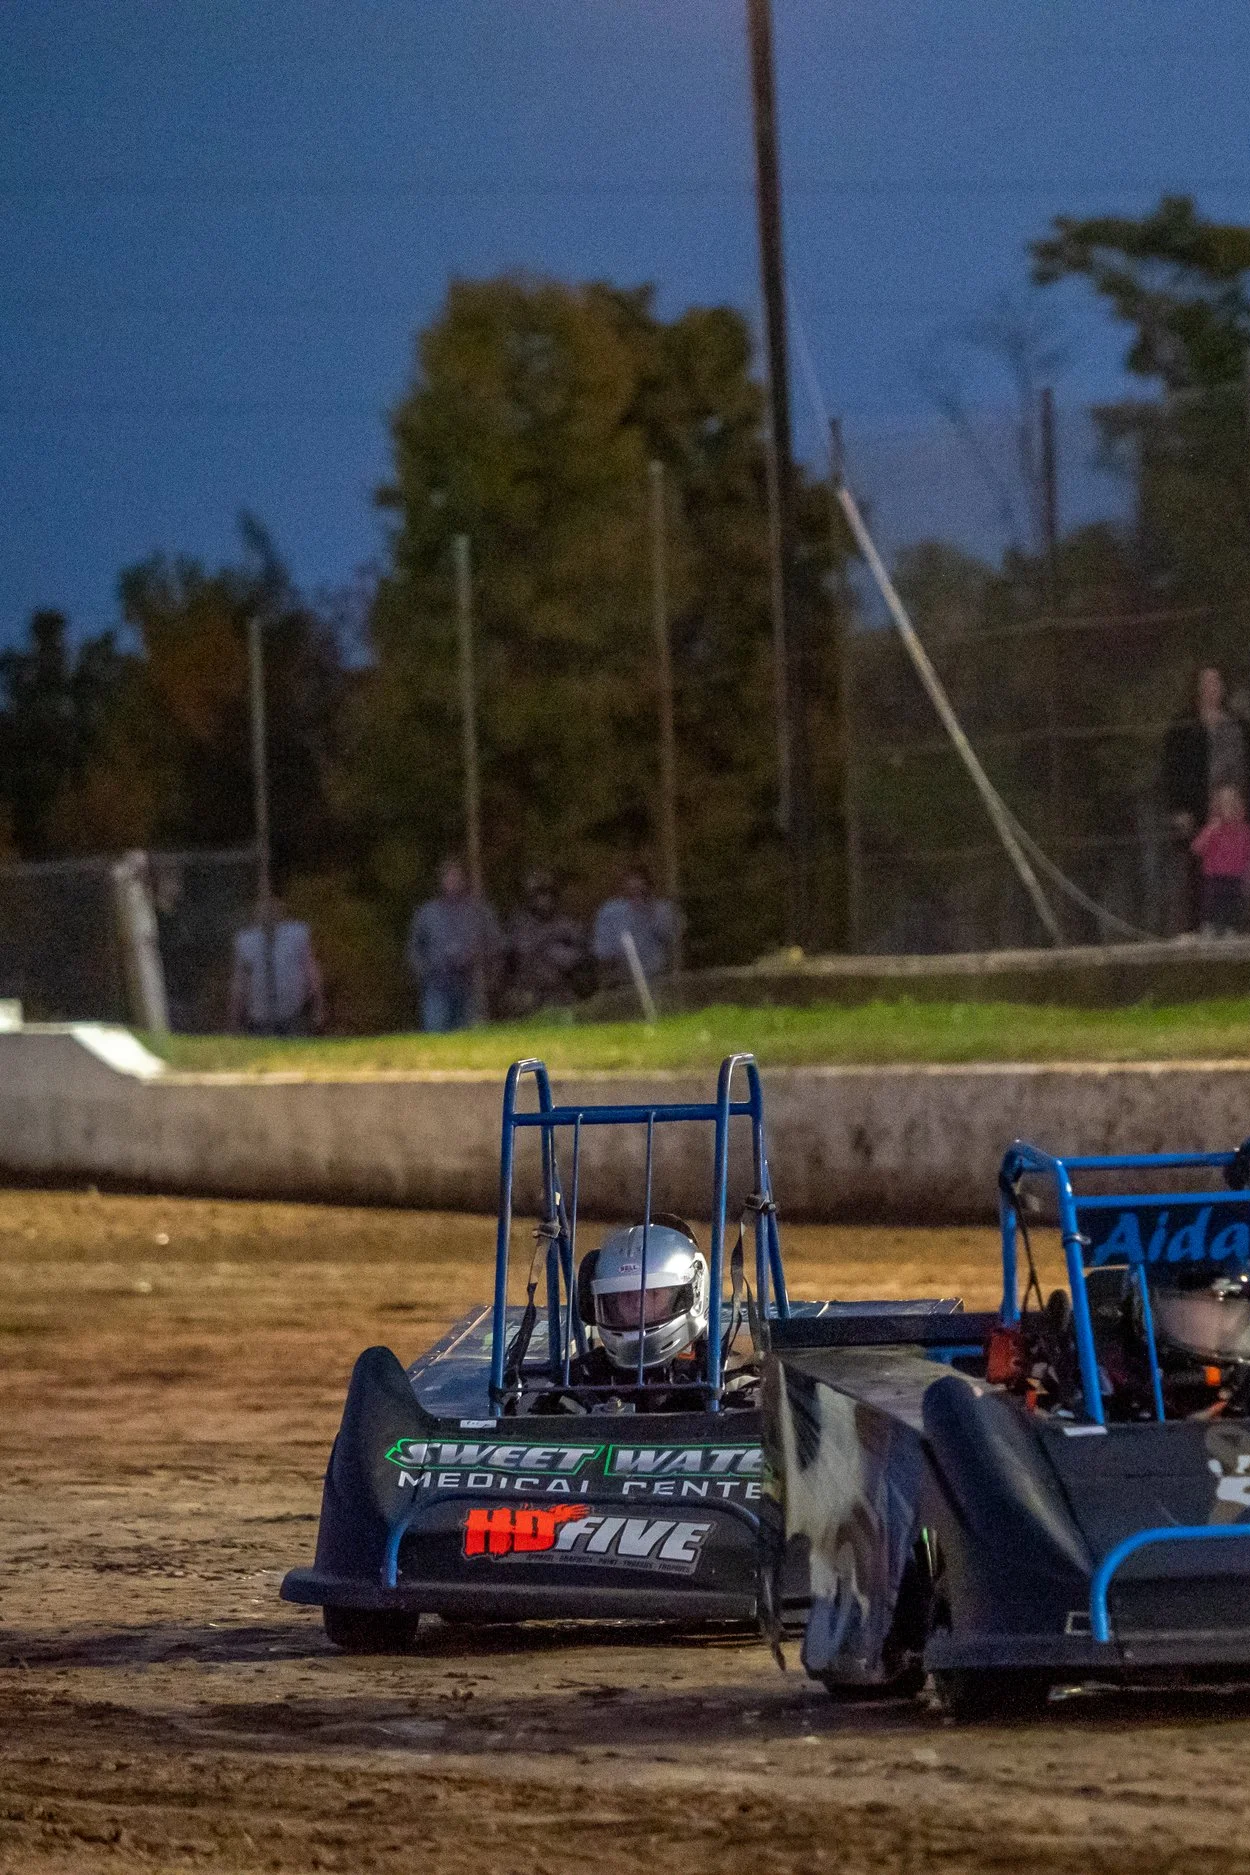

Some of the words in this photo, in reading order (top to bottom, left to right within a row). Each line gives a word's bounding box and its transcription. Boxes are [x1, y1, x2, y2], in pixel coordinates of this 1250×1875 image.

[400, 1443, 595, 1470] SWEET
[615, 1449, 764, 1472] WATE
[622, 1480, 761, 1499] CENTE
[554, 1516, 711, 1562] FIVE
